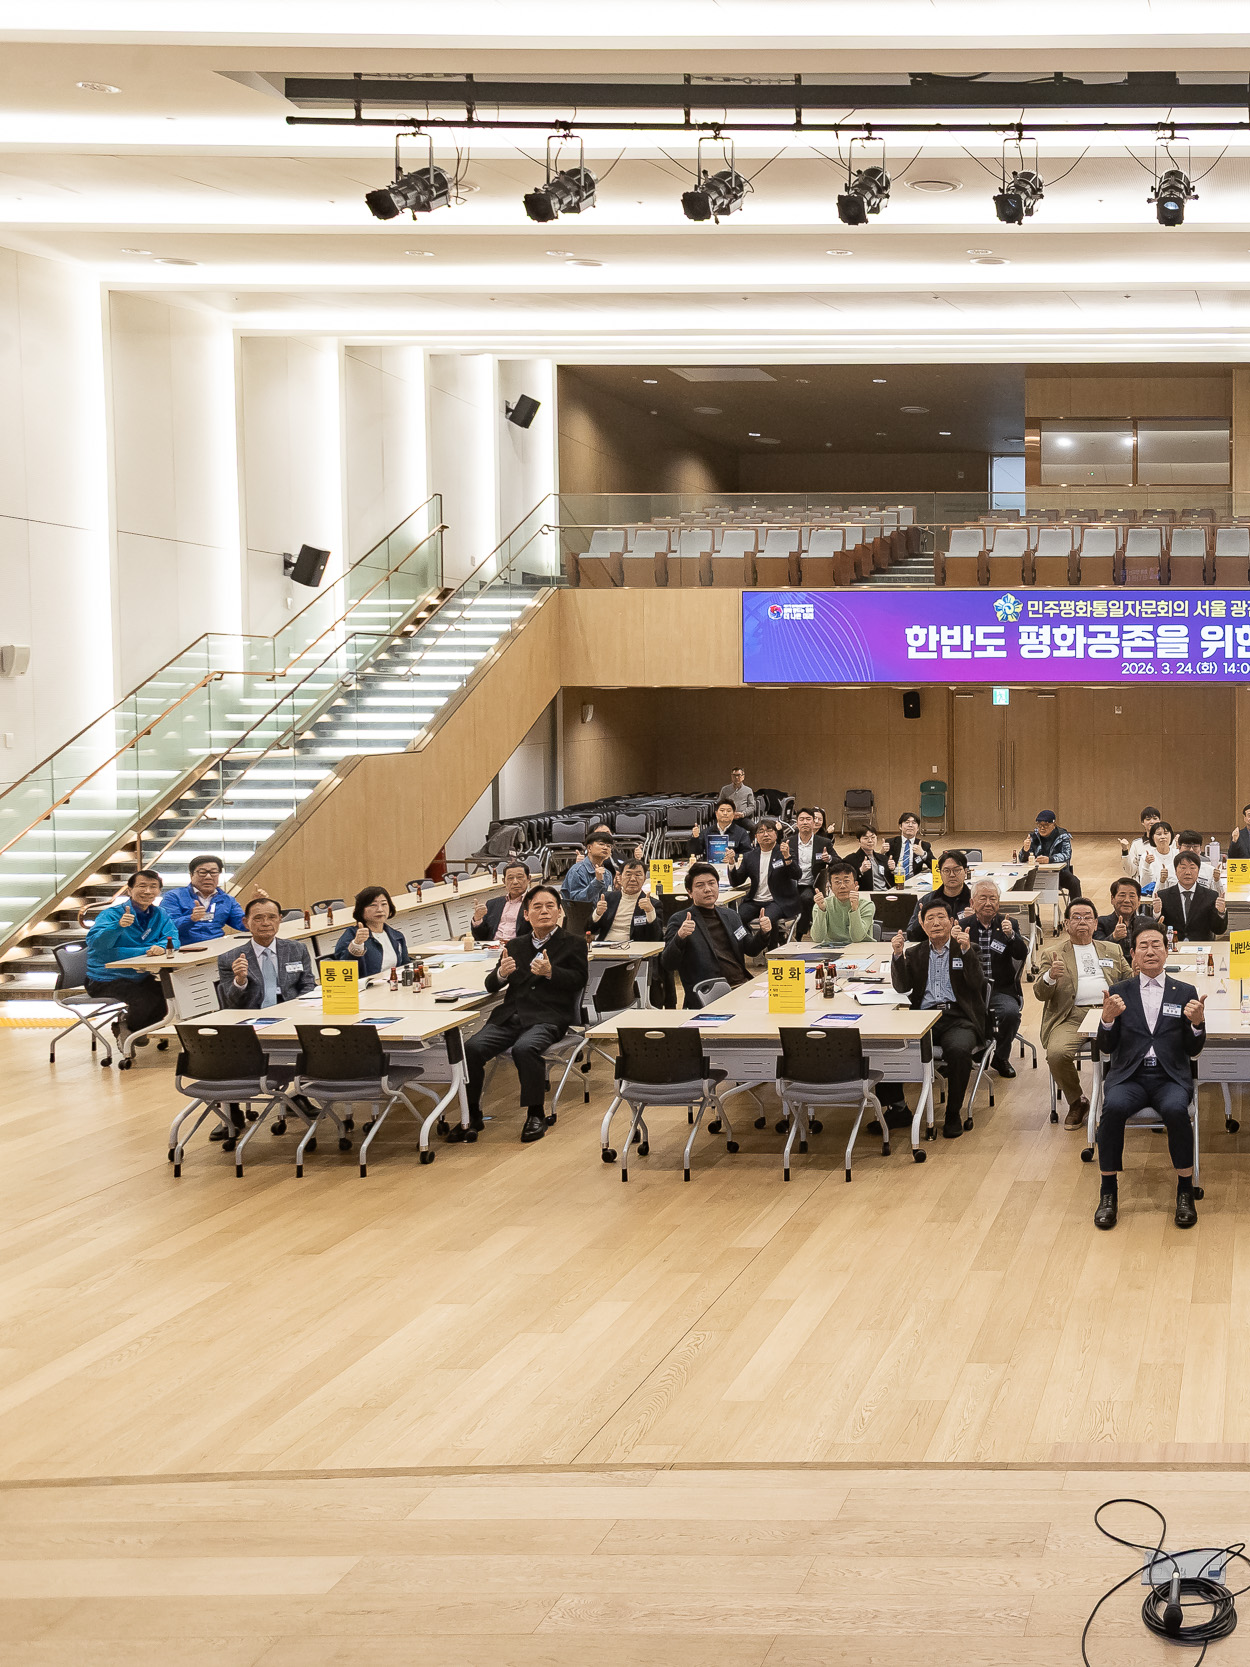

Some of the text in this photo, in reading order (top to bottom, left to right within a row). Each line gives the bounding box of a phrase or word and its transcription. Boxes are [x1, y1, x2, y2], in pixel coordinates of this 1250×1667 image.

[1028, 600, 1188, 617] 민주평화통일자문회의
[1194, 600, 1226, 617] 서울
[905, 625, 1007, 659] 한반도
[1018, 624, 1190, 659] 평화공존을
[1121, 663, 1158, 674] 2026.
[1161, 663, 1174, 674] 3.
[652, 864, 671, 873] 화합
[1229, 863, 1249, 873] 공동
[324, 968, 353, 982] 통일
[771, 967, 802, 981] 평화
